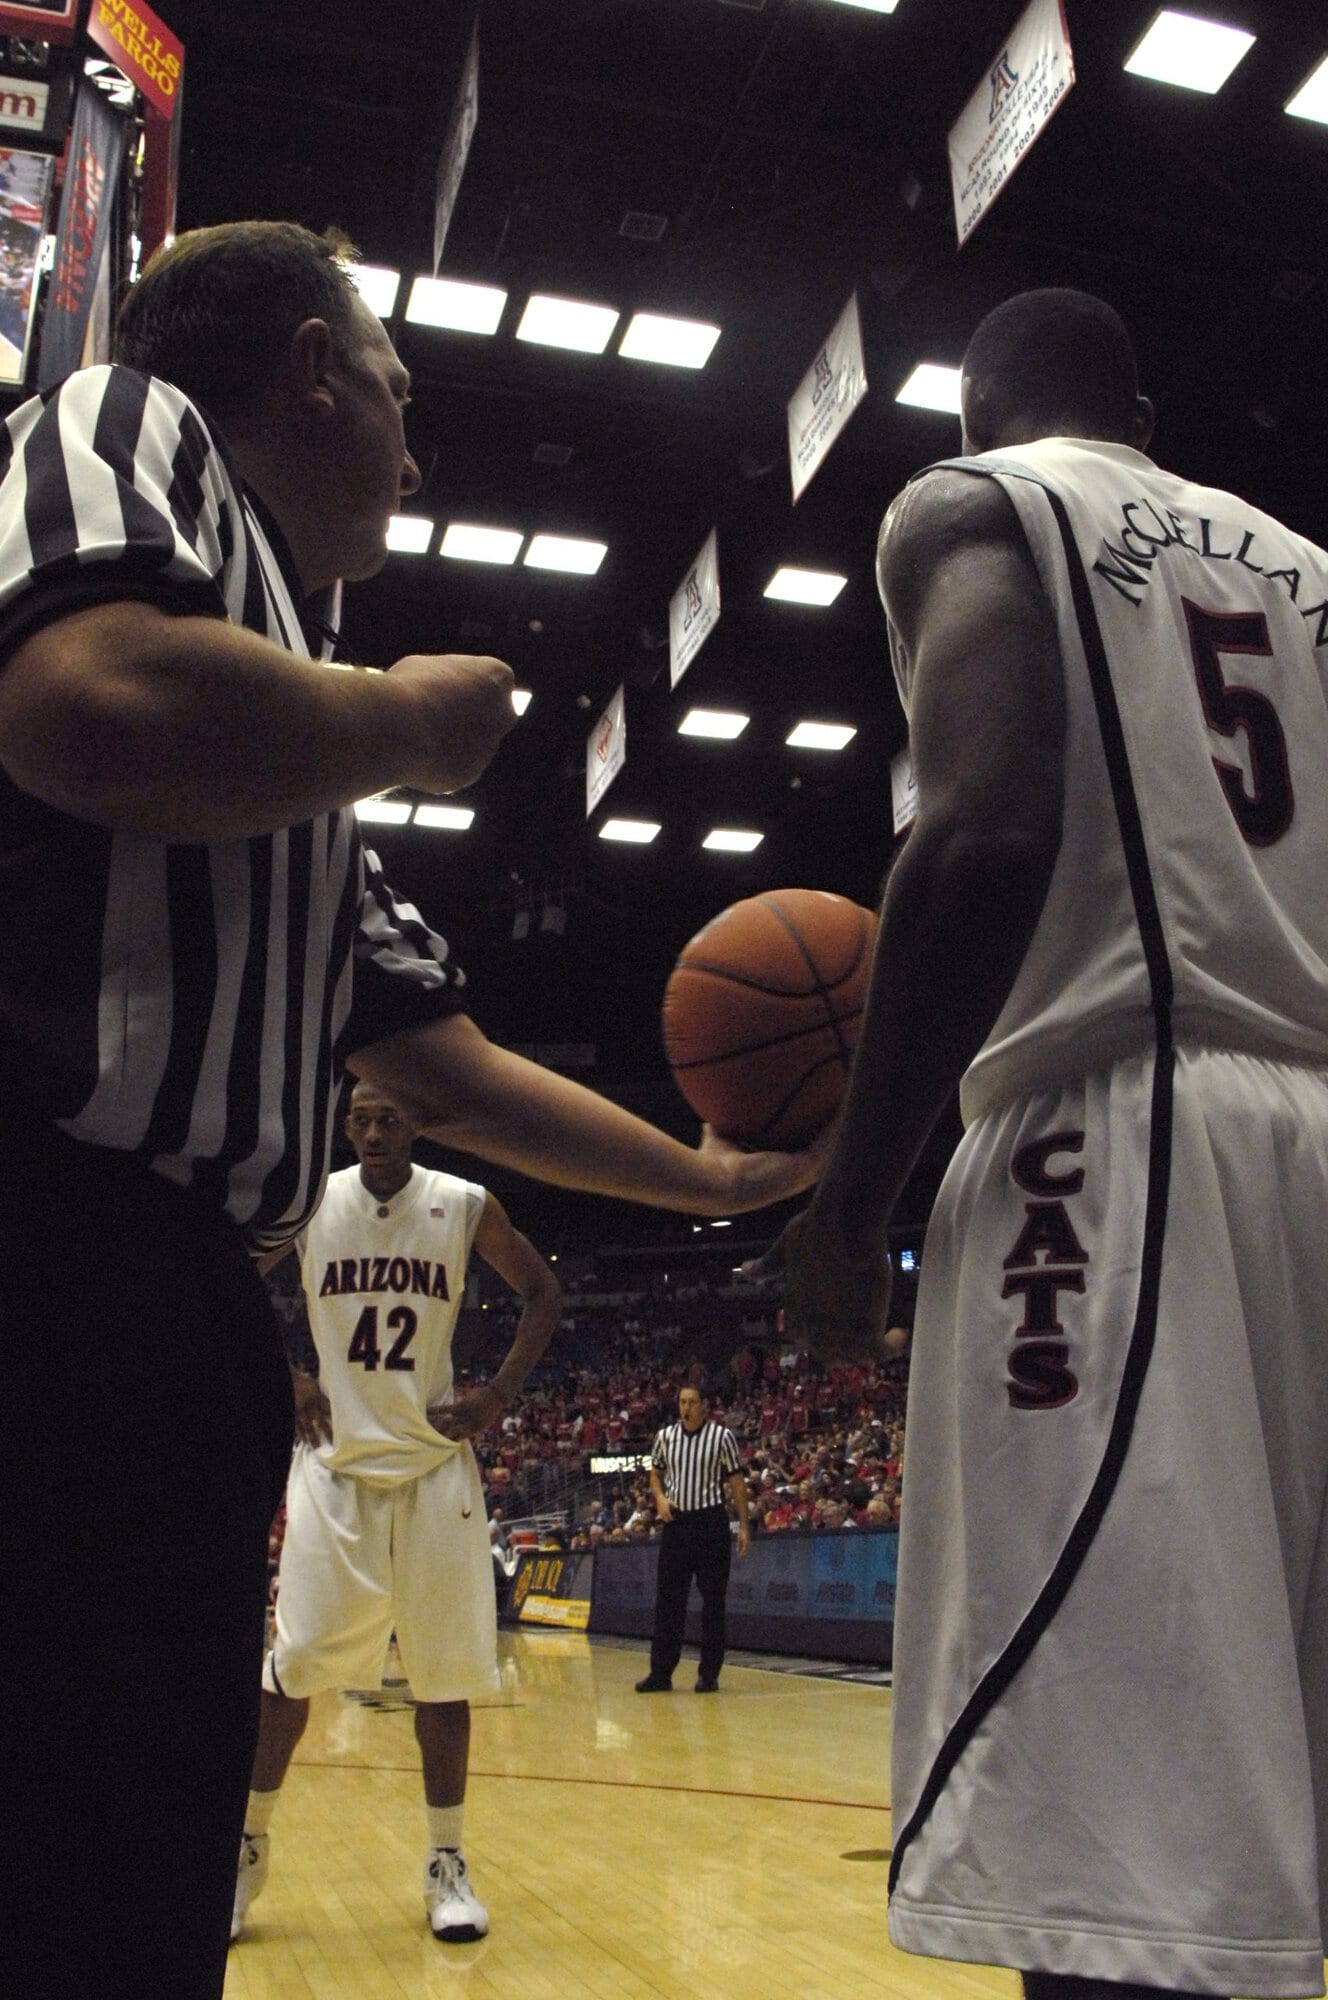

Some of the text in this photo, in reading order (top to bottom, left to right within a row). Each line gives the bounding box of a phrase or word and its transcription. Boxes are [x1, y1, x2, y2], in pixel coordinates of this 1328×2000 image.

[98, 2, 174, 96] FARGO
[1023, 50, 1059, 109] SIXTEN
[988, 162, 1008, 198] 2001
[1013, 122, 1036, 159] 2002
[1181, 595, 1295, 848] 5
[318, 1256, 450, 1302] ARIZONA
[1001, 1130, 1090, 1411] CATS
[347, 1305, 418, 1371] 42
